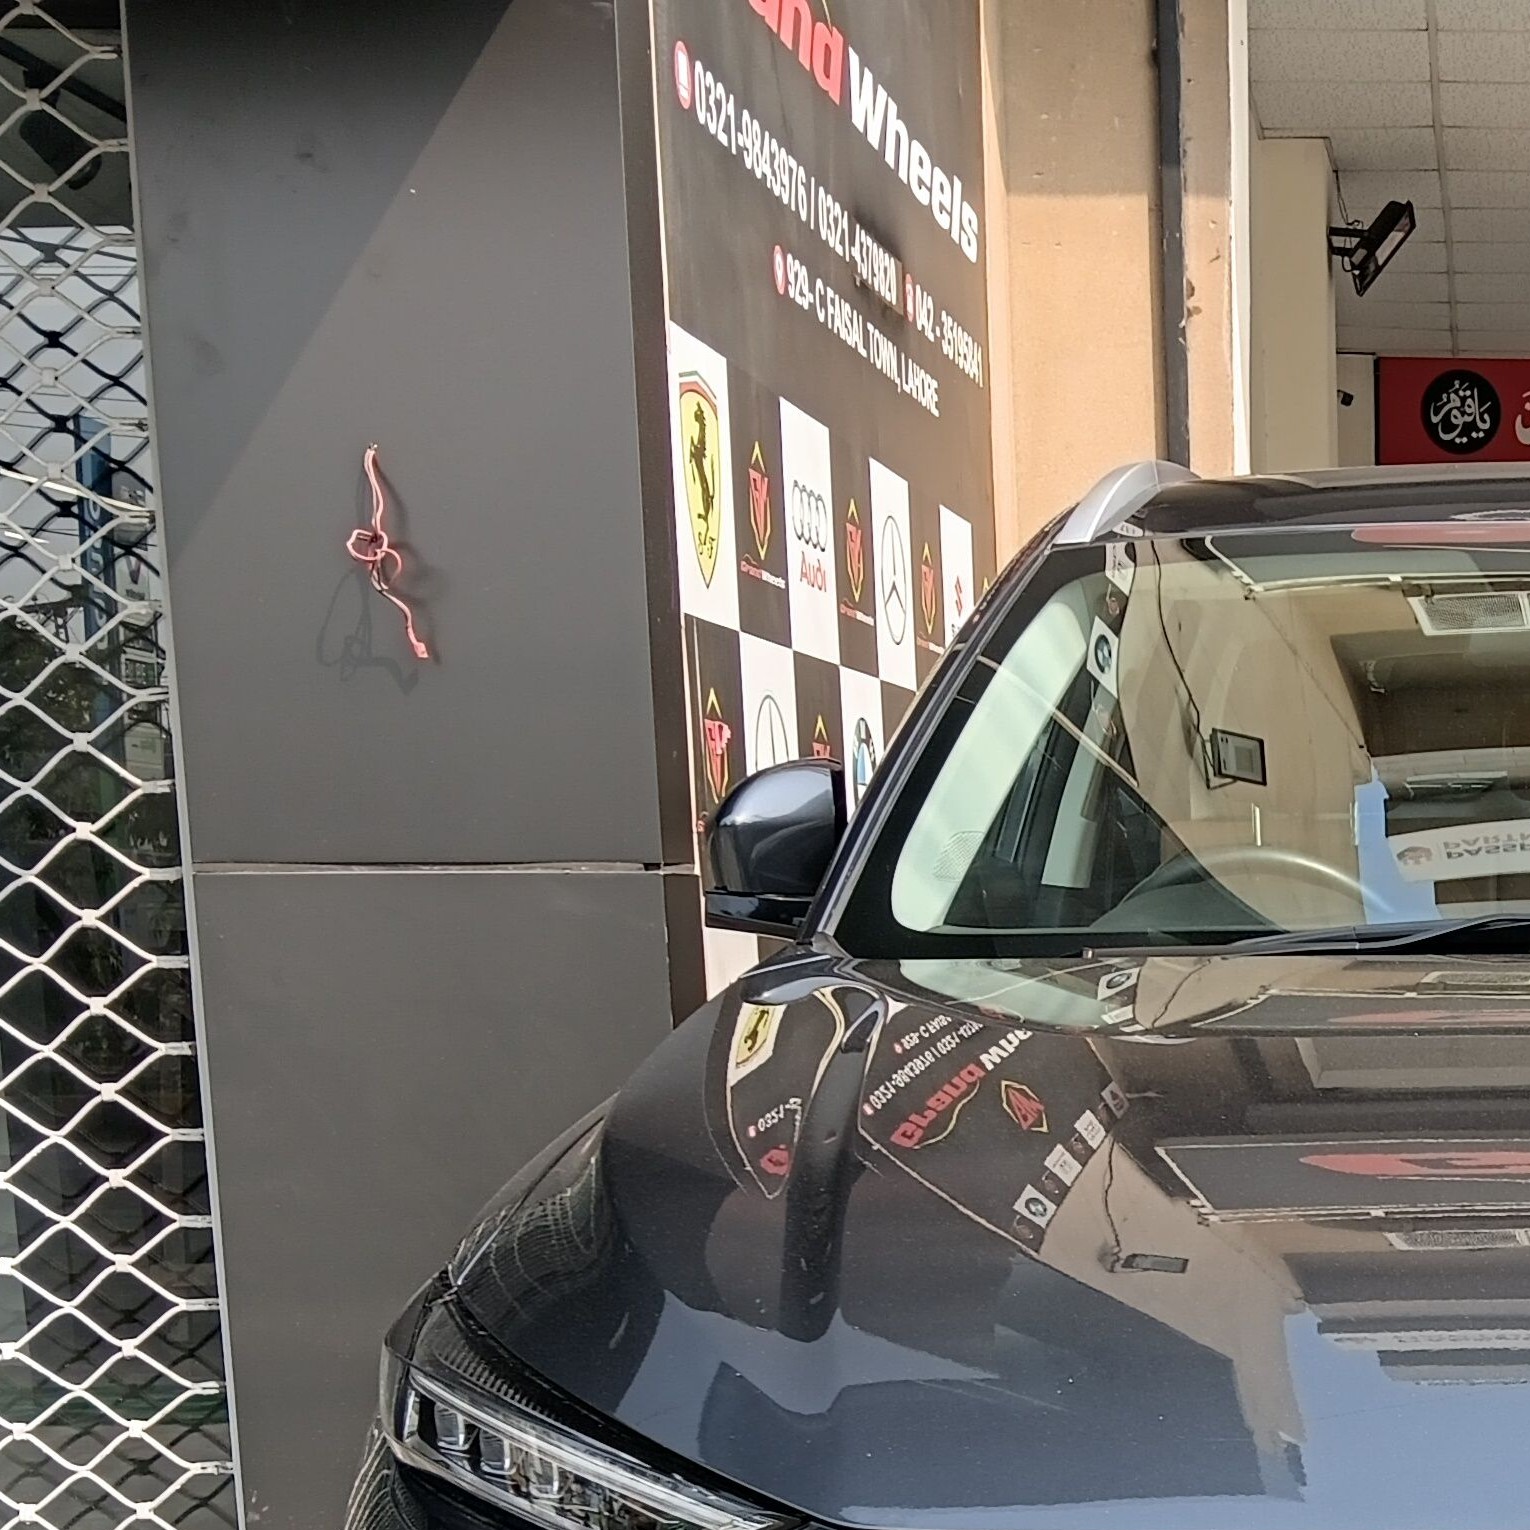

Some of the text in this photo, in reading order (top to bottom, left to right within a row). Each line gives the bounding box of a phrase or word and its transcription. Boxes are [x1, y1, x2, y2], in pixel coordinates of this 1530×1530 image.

[695, 60, 807, 221] 0321-9843976
[849, 46, 978, 264] Wheels
[826, 286, 867, 358] FAISAL
[901, 352, 939, 417] LAHORE
[800, 551, 827, 592] Audi
